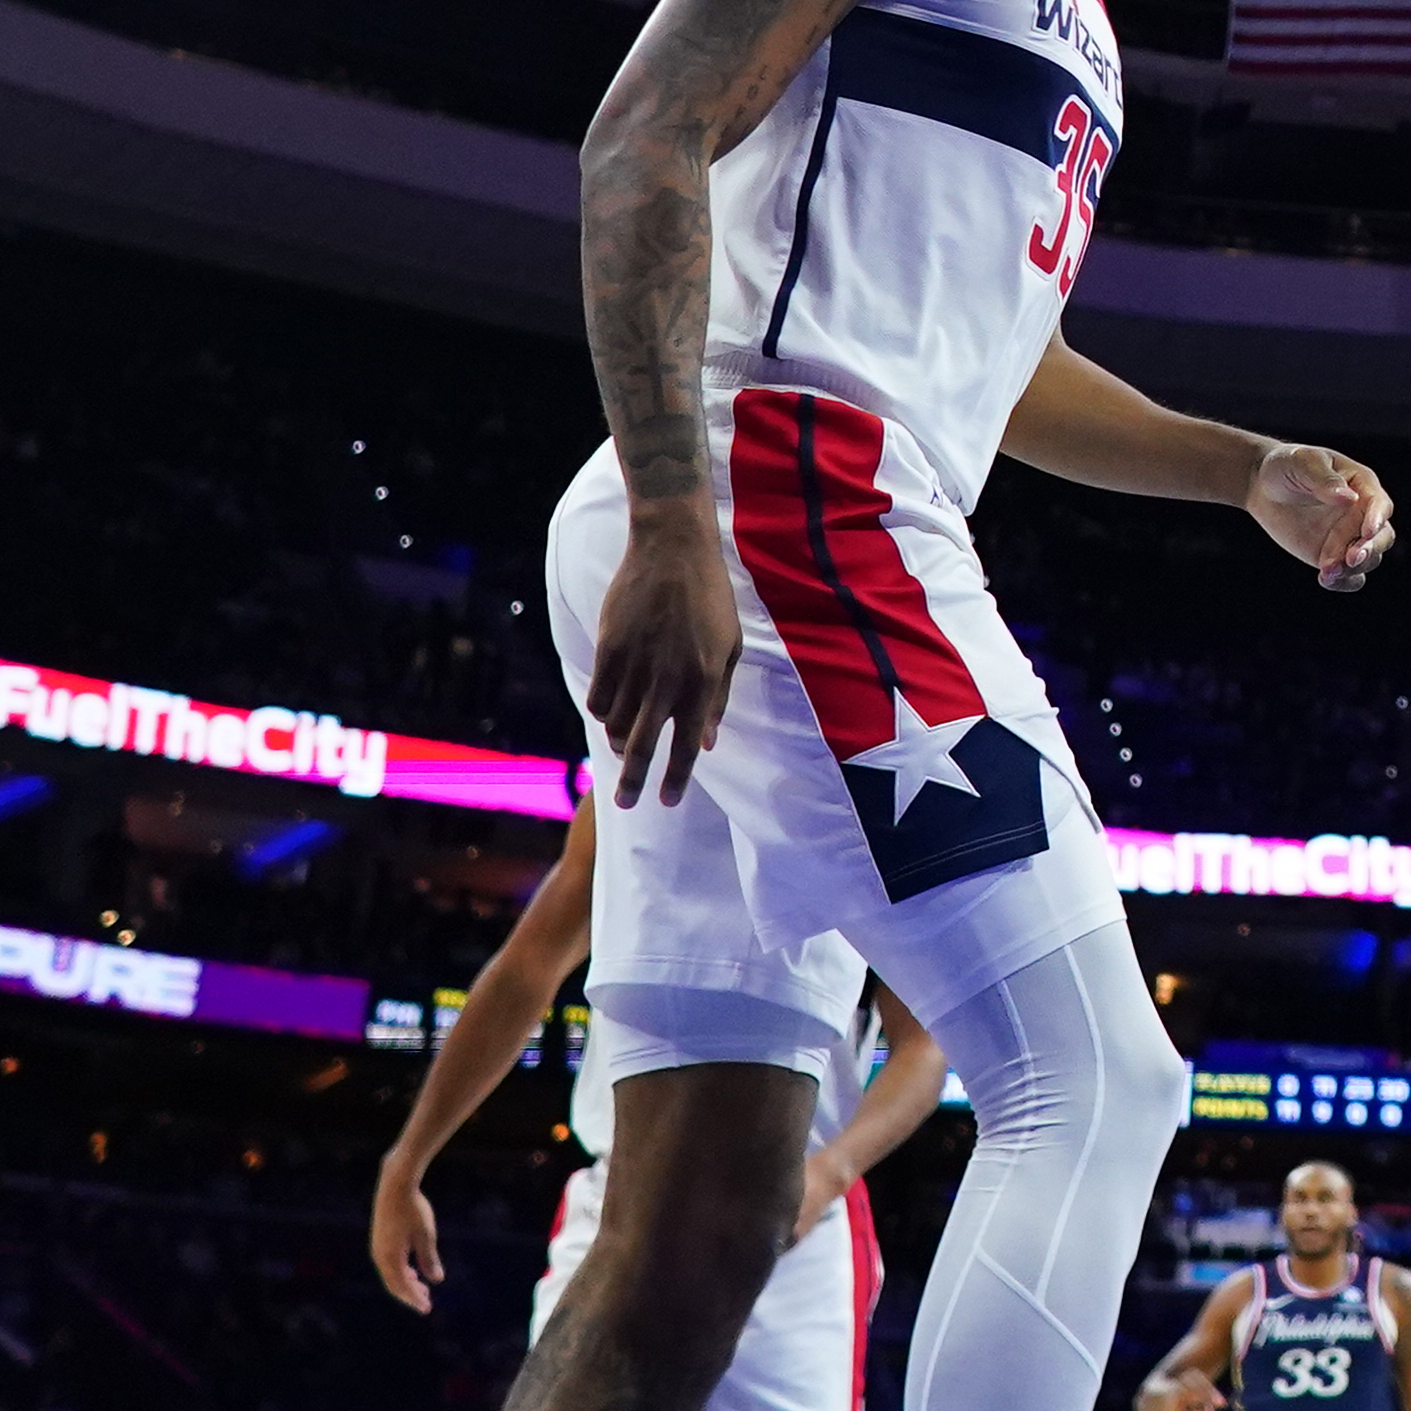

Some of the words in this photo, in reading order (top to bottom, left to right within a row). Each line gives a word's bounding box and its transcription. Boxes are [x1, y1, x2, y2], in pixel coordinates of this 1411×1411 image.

[1026, 94, 1112, 298] 35
[0, 664, 389, 798] FuelTheCity
[1271, 1346, 1352, 1400] 33
